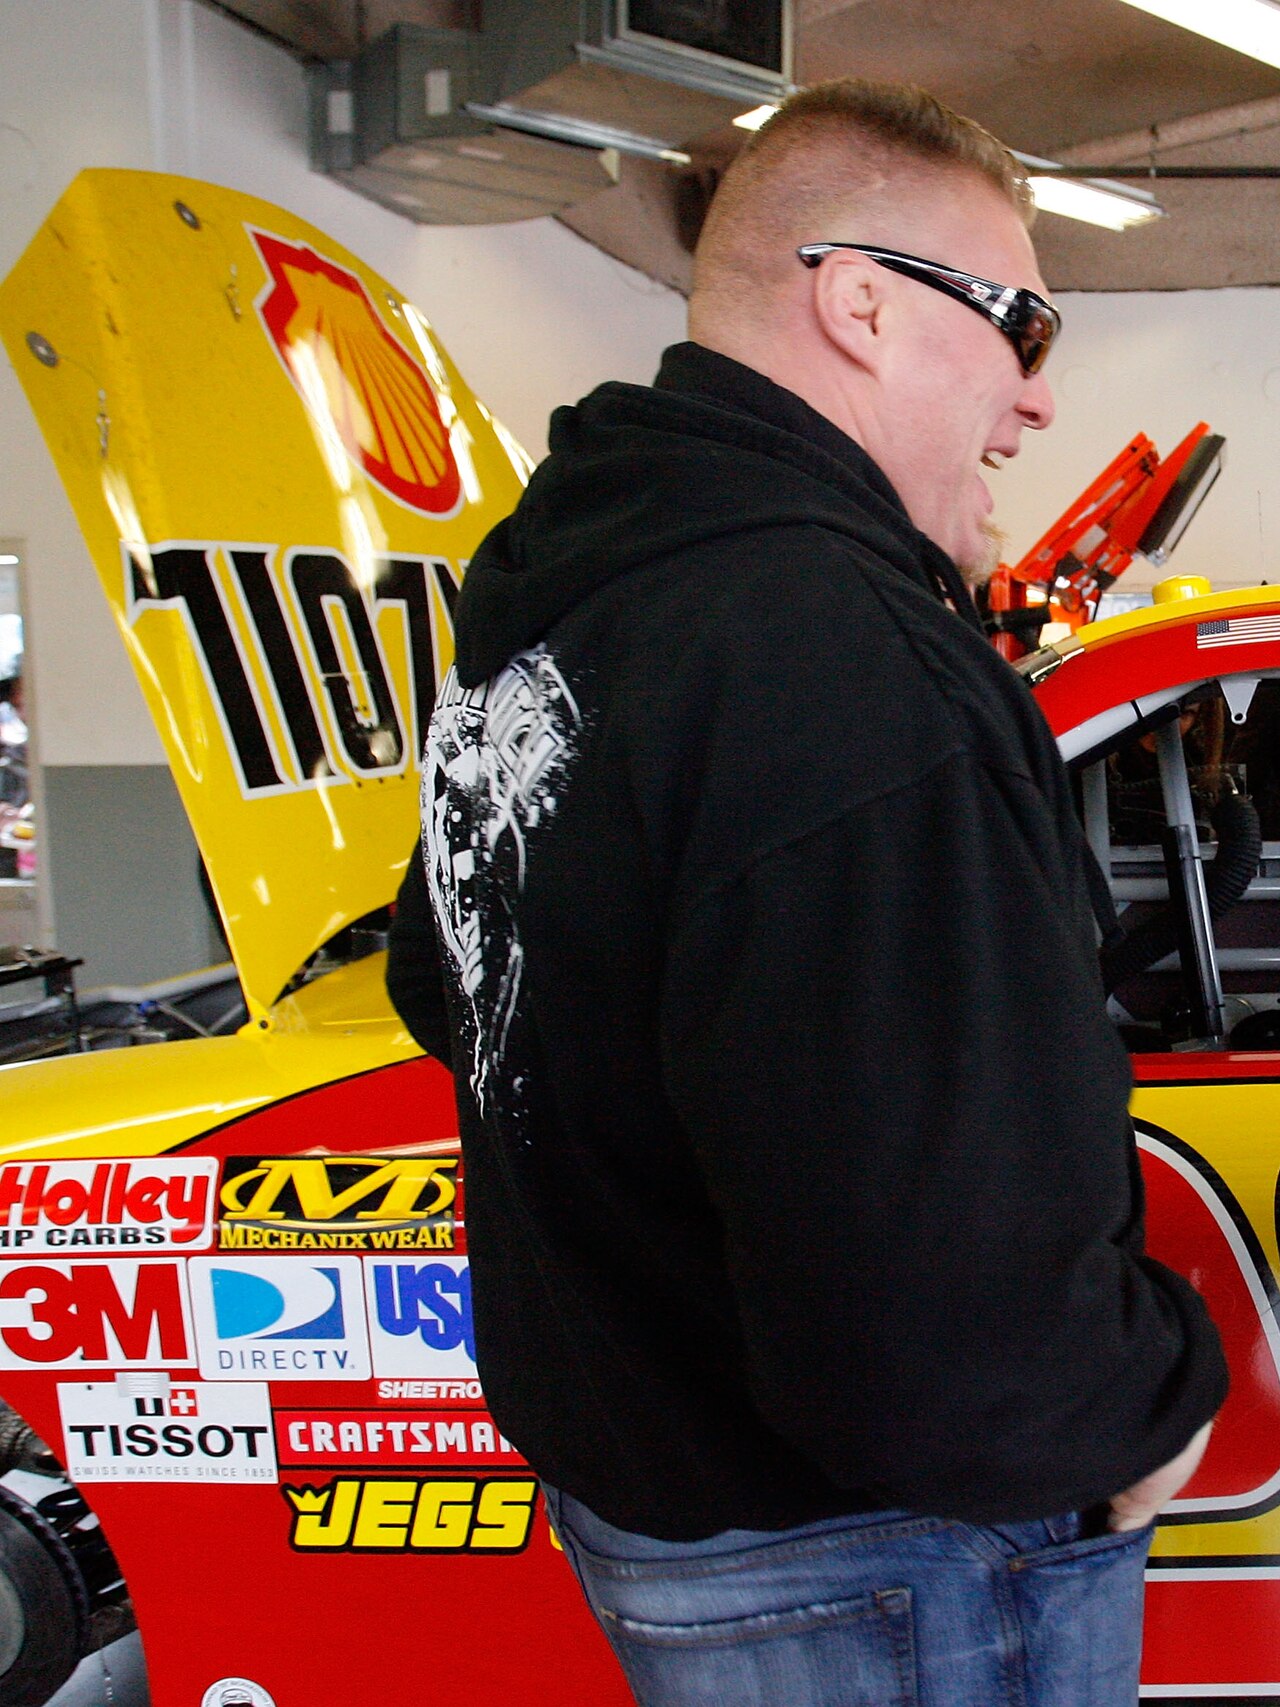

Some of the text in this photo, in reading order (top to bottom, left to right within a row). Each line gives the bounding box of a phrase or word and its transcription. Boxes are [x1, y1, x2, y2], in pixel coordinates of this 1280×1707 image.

[0, 1163, 210, 1243] Holley
[46, 1226, 166, 1246] CARBS
[218, 1221, 454, 1250] MECHANIX WEAR
[0, 1264, 189, 1363] 3M
[218, 1349, 350, 1371] DIRECTV
[69, 1424, 269, 1459] TISSOT
[73, 1466, 118, 1478] SWISS
[126, 1466, 190, 1478] WATCHES
[196, 1466, 238, 1477] SINCE
[292, 1480, 538, 1550] JEGS
